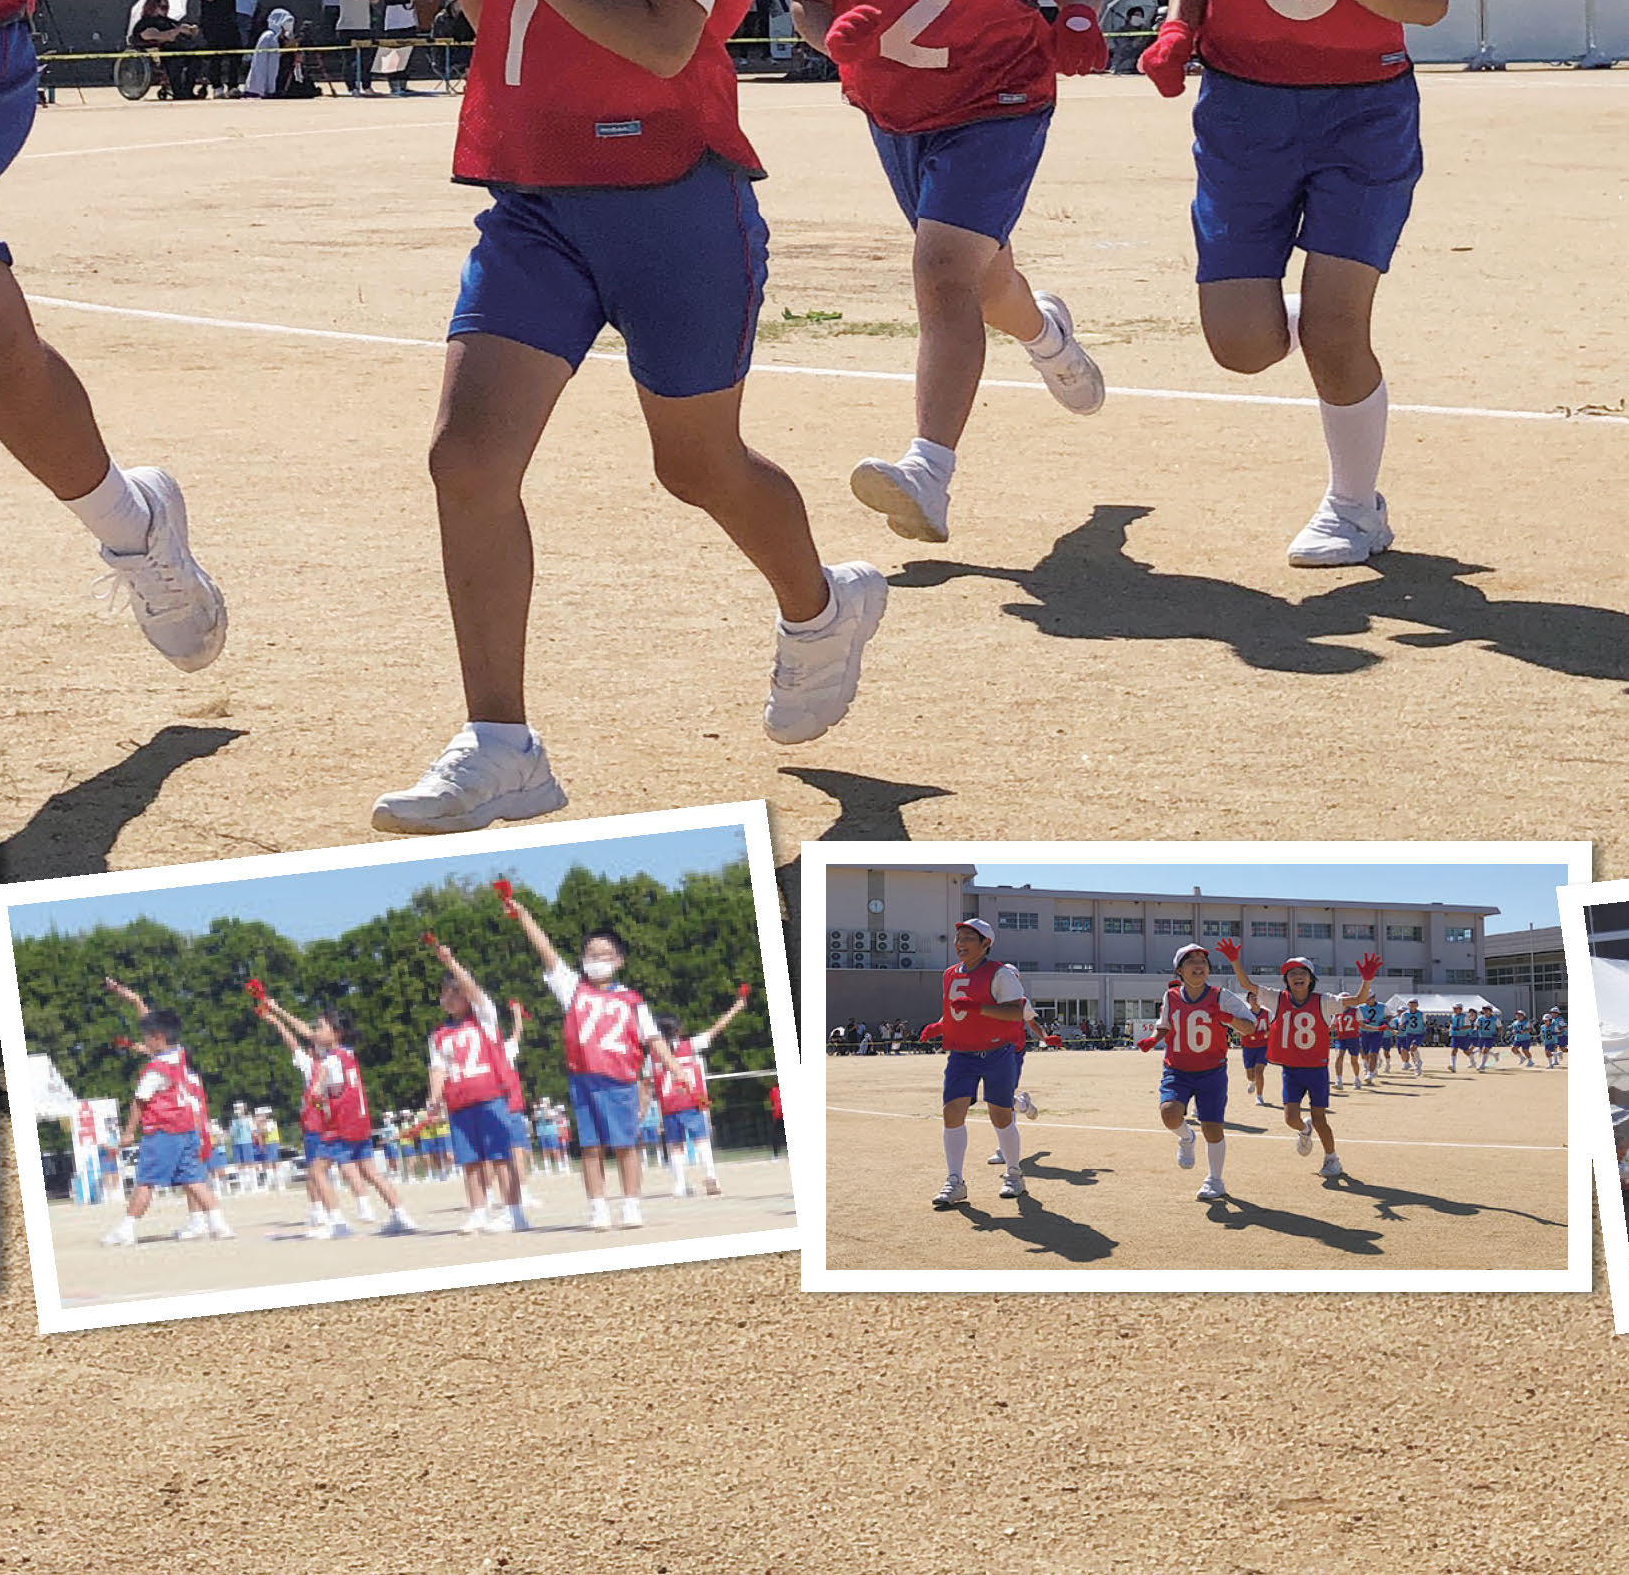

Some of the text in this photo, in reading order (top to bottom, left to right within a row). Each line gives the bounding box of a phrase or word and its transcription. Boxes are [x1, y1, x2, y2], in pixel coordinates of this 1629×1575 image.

[949, 978, 970, 1021] 5
[1171, 1009, 1213, 1053] 16
[1281, 1010, 1317, 1050] 18
[1336, 1014, 1355, 1032] 12
[1409, 1015, 1418, 1029] 3
